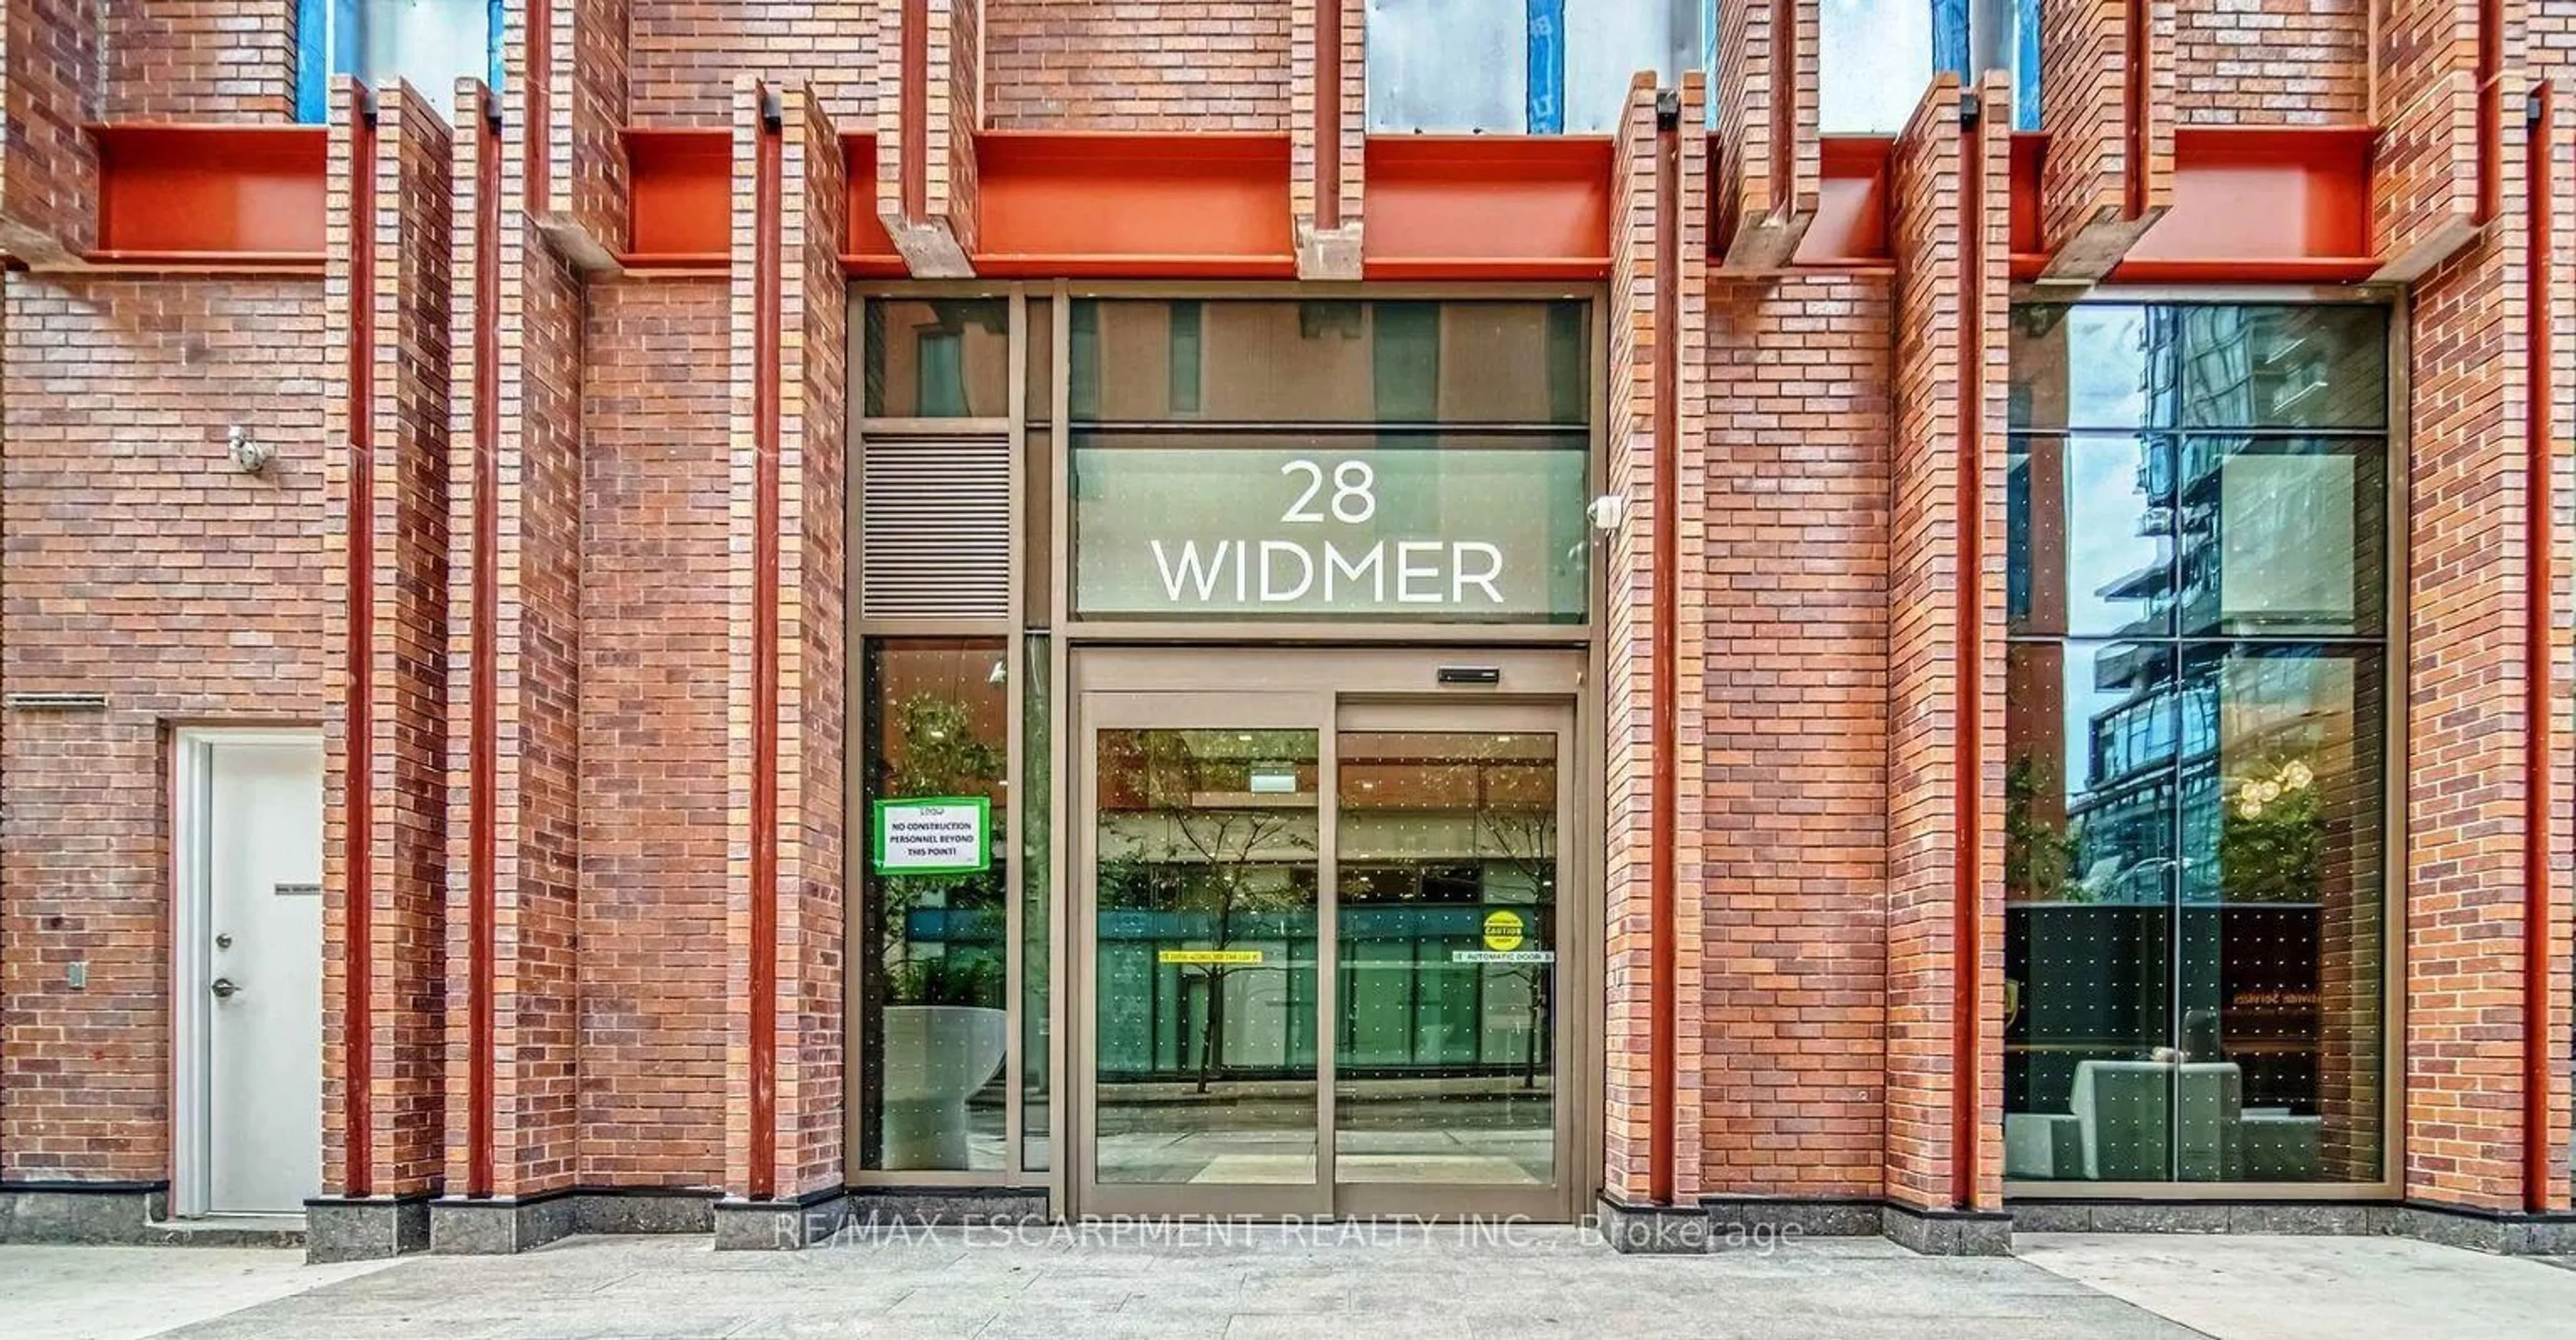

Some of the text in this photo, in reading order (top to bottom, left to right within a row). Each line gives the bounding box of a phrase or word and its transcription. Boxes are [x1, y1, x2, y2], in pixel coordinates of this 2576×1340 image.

[1280, 459, 1377, 524] 28
[1150, 539, 1505, 603] WIDMER
[892, 822, 971, 831] NO CONSTRUCTION
[890, 835, 975, 843] PERSONNEL BEYOND
[907, 848, 926, 856] THIS
[1485, 927, 1521, 936] CAUTION
[1467, 952, 1542, 961] AUTOMATIC DOOR
